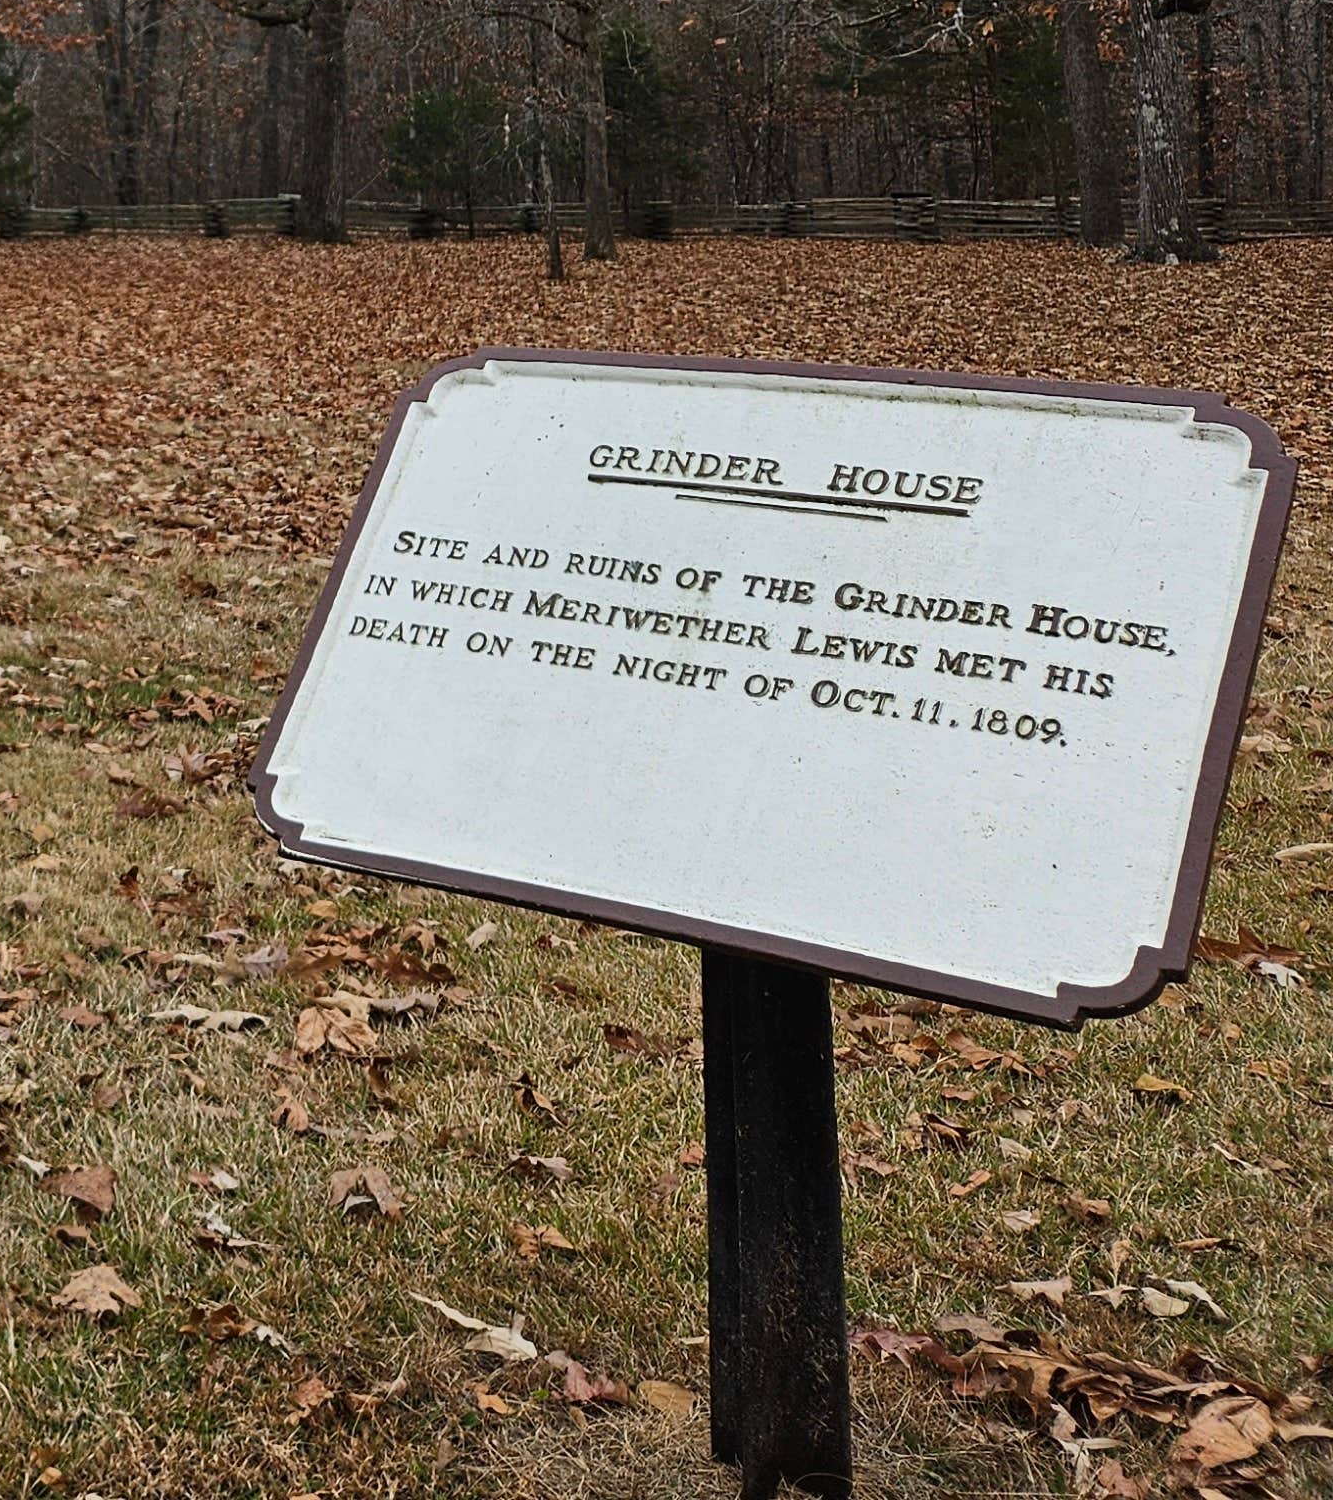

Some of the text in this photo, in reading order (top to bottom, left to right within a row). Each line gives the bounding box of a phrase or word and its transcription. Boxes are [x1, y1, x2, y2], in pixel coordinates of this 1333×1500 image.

[589, 444, 984, 506] GRINDER HOUSE
[363, 574, 1115, 700] IN WHICH MERIWETHER LEWIS MET HIS
[393, 530, 1177, 658] SITE AND RUINS OF THE GRINDER HOUSE,
[348, 615, 450, 649] DEATH
[465, 631, 514, 658] ON
[530, 640, 597, 671] THE
[612, 653, 728, 691] NIGHT
[743, 673, 795, 701] OF
